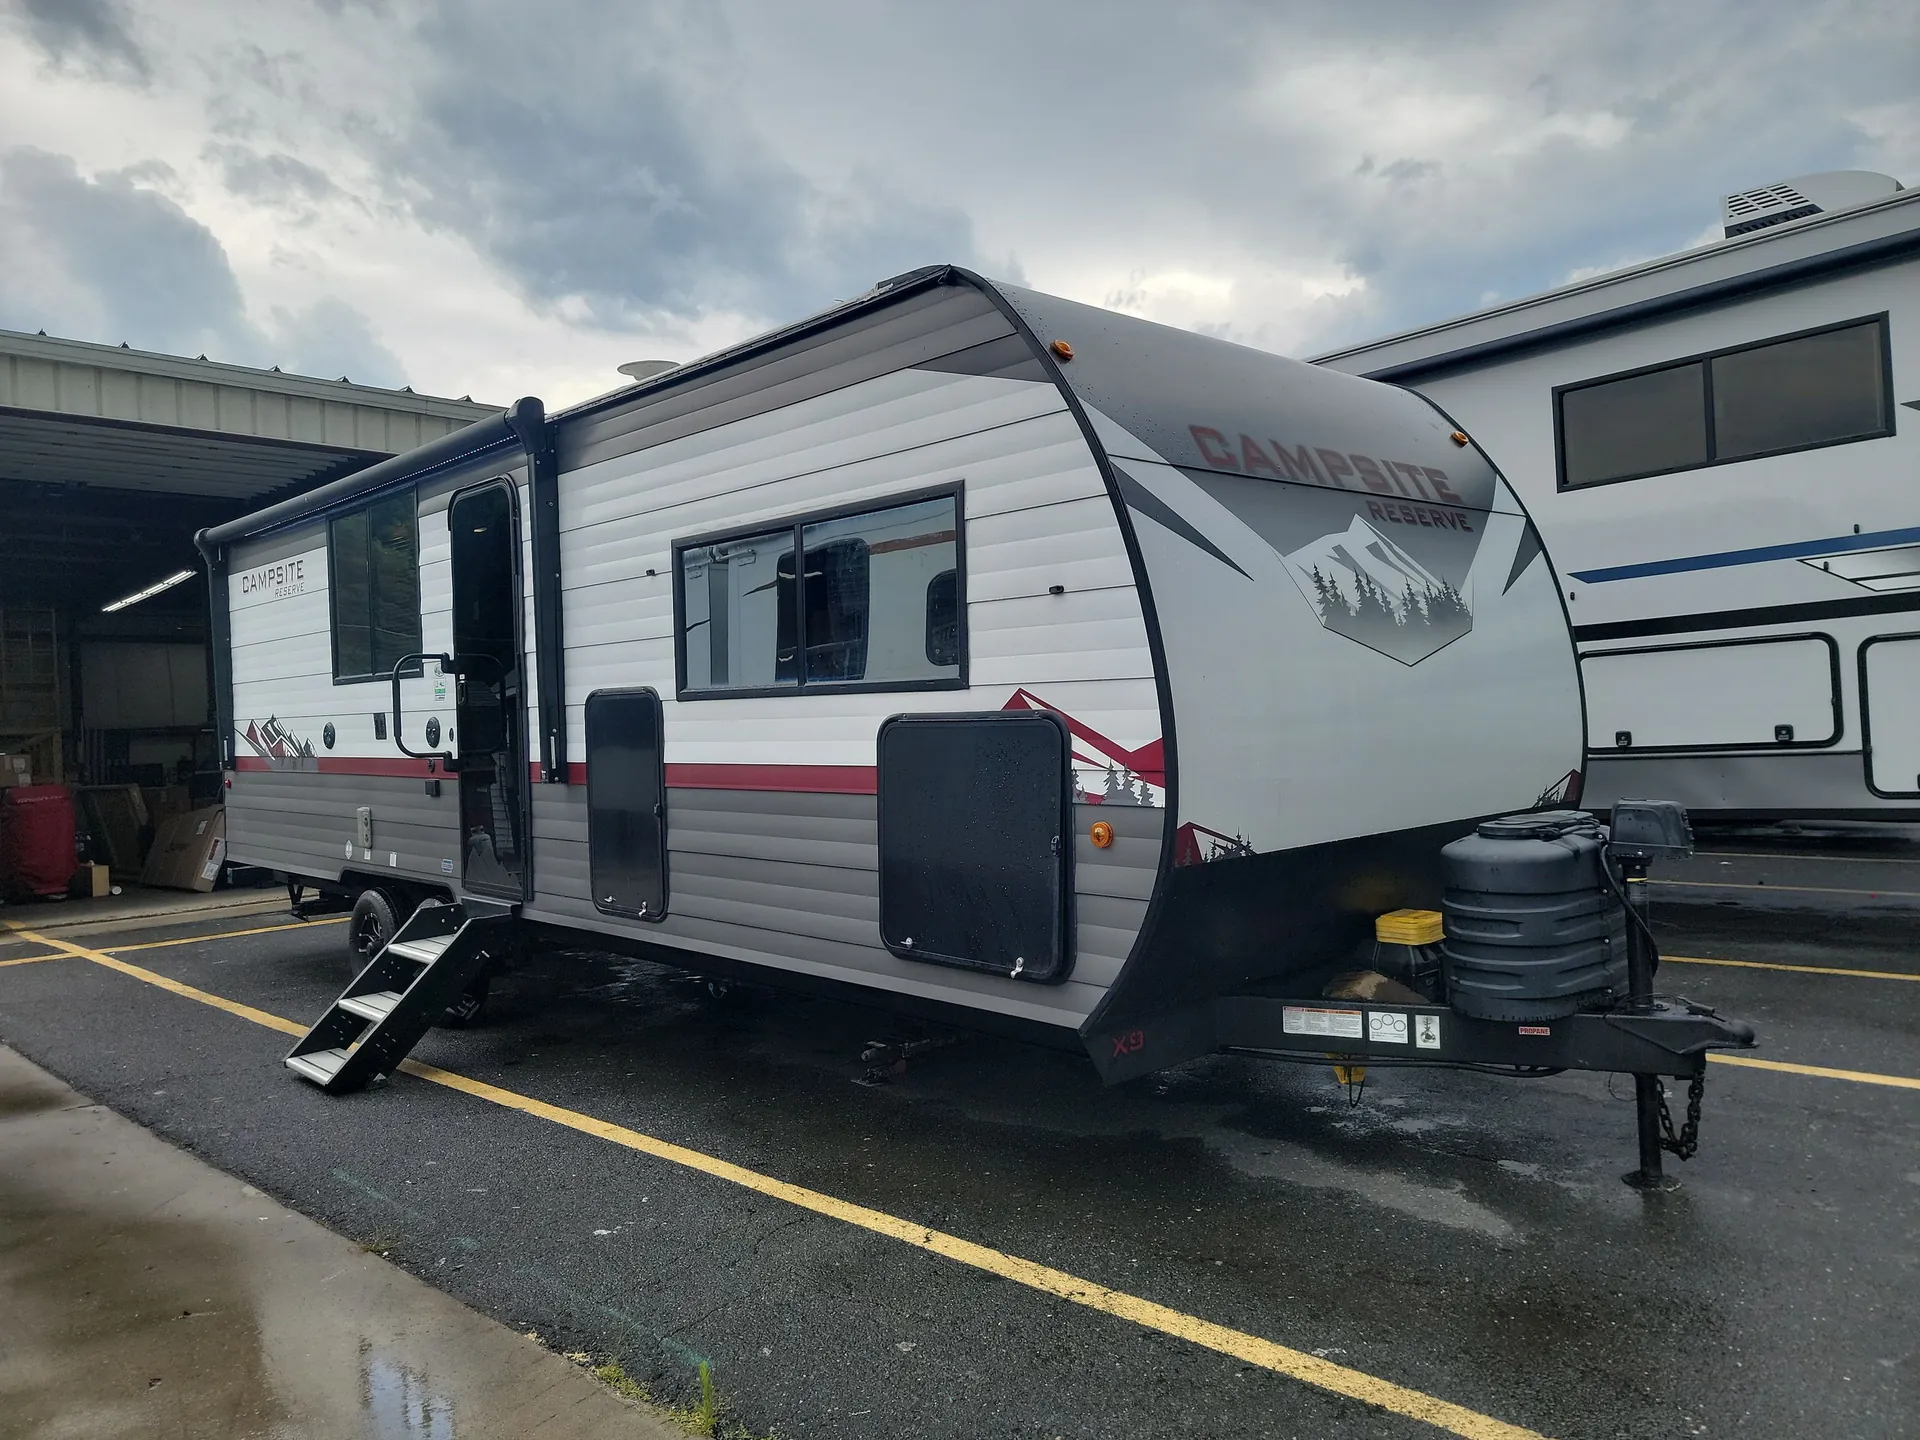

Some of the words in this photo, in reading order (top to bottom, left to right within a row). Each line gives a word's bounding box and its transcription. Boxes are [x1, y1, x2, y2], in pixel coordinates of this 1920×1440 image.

[1189, 425, 1461, 503] CAMPSITE
[1366, 501, 1473, 532] RESERVE
[243, 560, 303, 593] CAMPSITE
[275, 582, 304, 597] RESERVE
